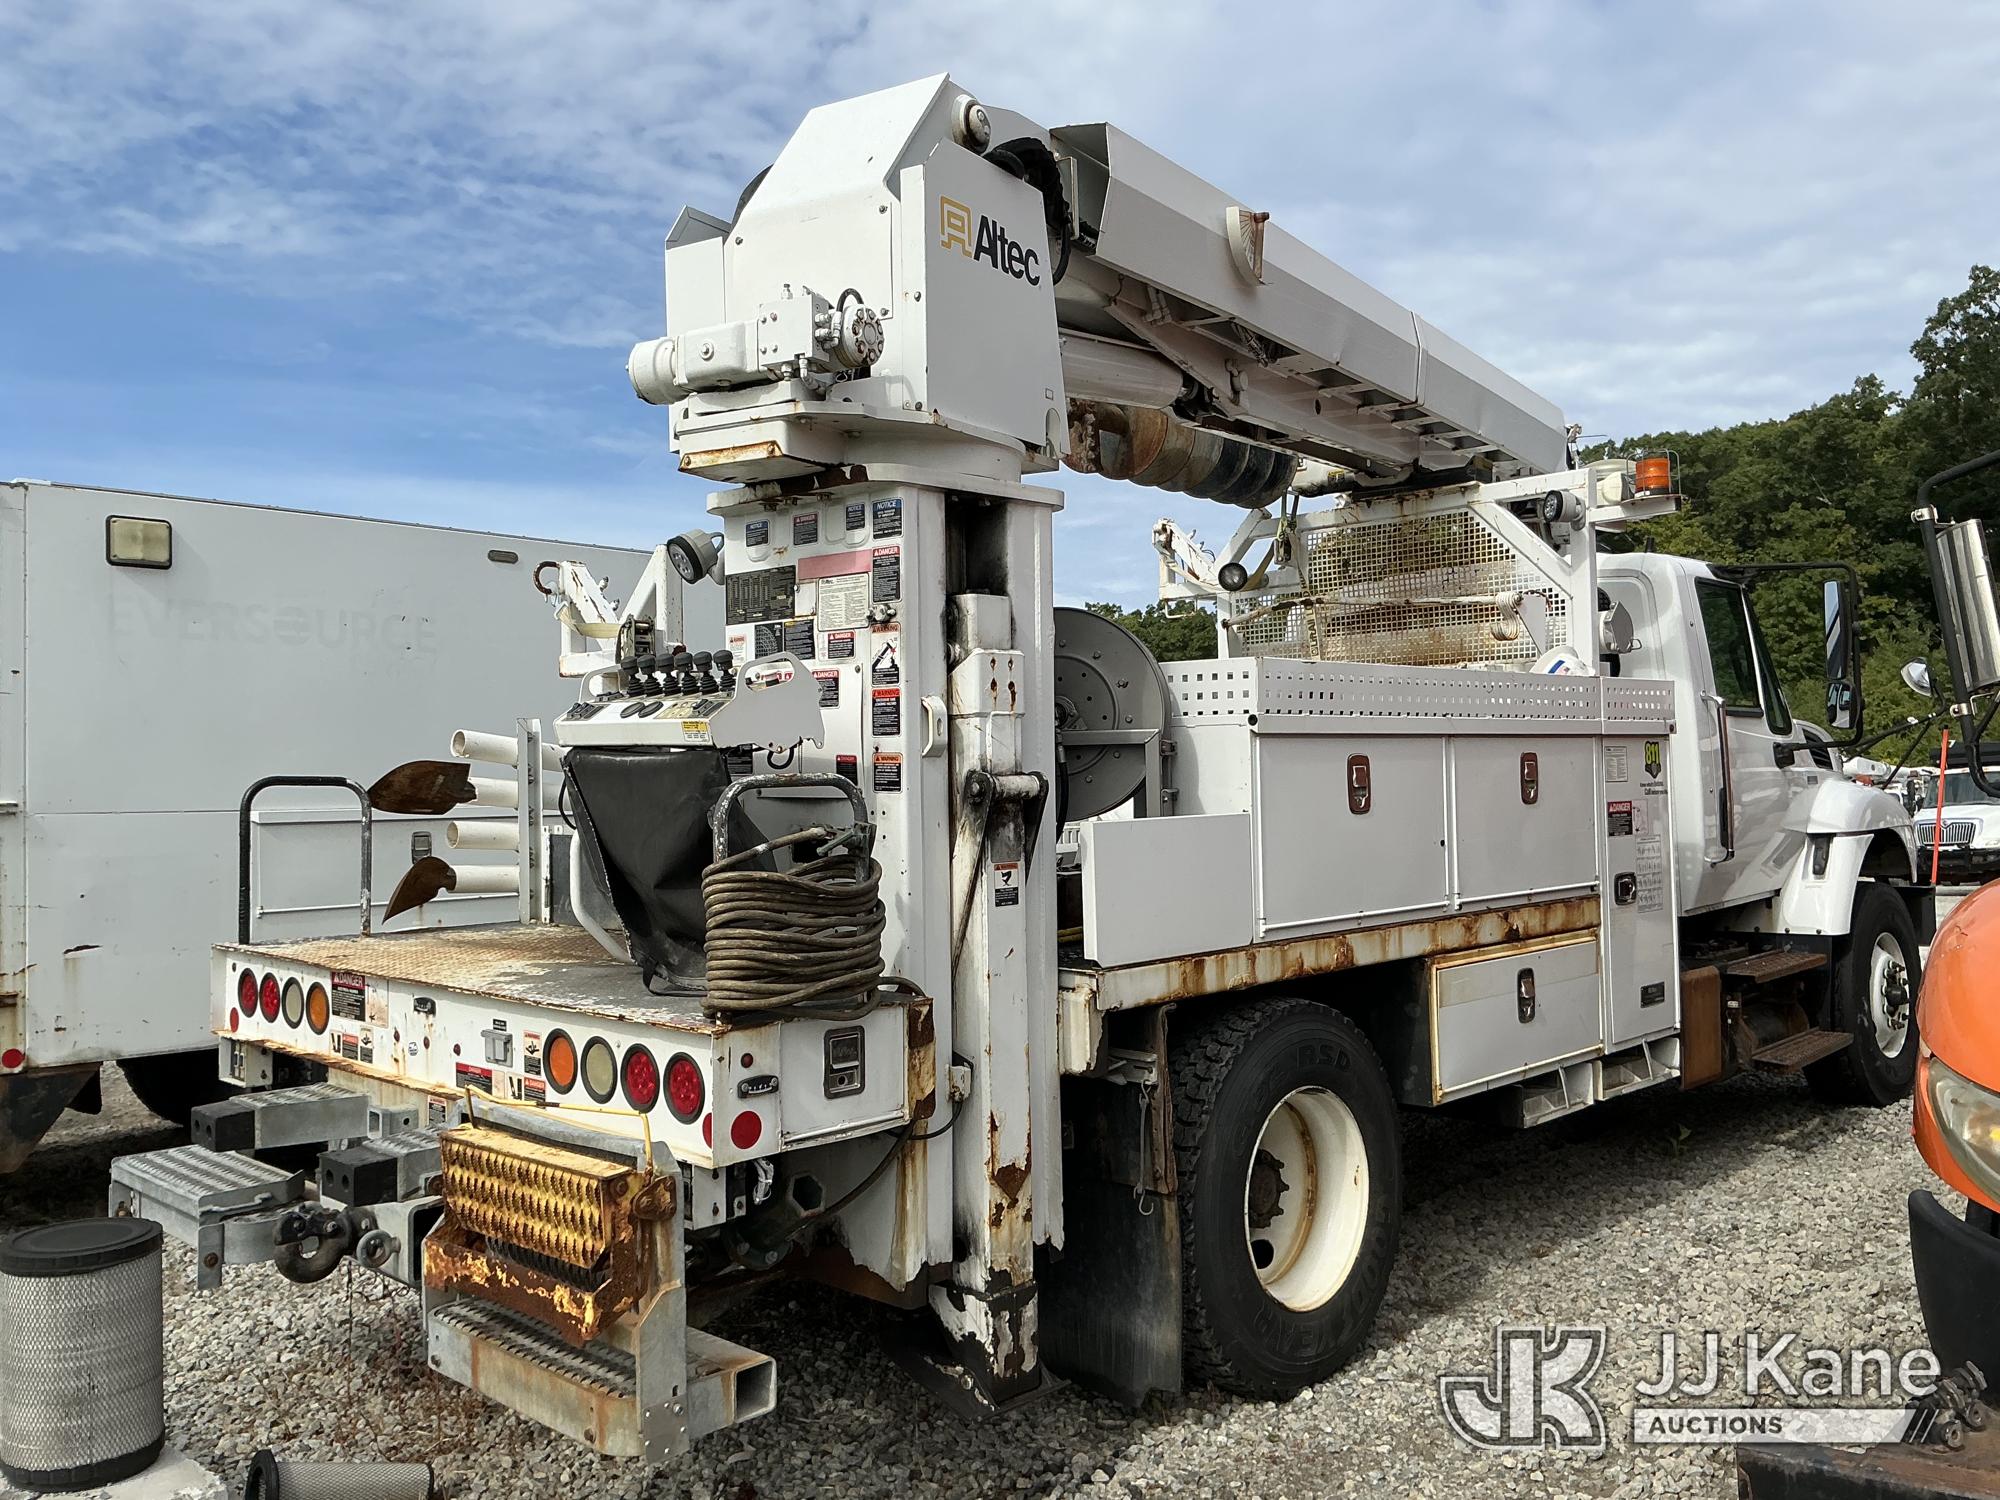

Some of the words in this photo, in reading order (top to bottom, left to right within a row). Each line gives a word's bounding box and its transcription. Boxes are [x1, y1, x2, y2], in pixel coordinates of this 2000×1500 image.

[974, 214, 1040, 286] Altec
[877, 499, 897, 510] NOTICE
[879, 547, 898, 556] DANGER
[817, 670, 838, 678] DANGER
[1645, 741, 1660, 765] 811
[1612, 802, 1631, 811] DANGER
[339, 973, 363, 987] DANGER
